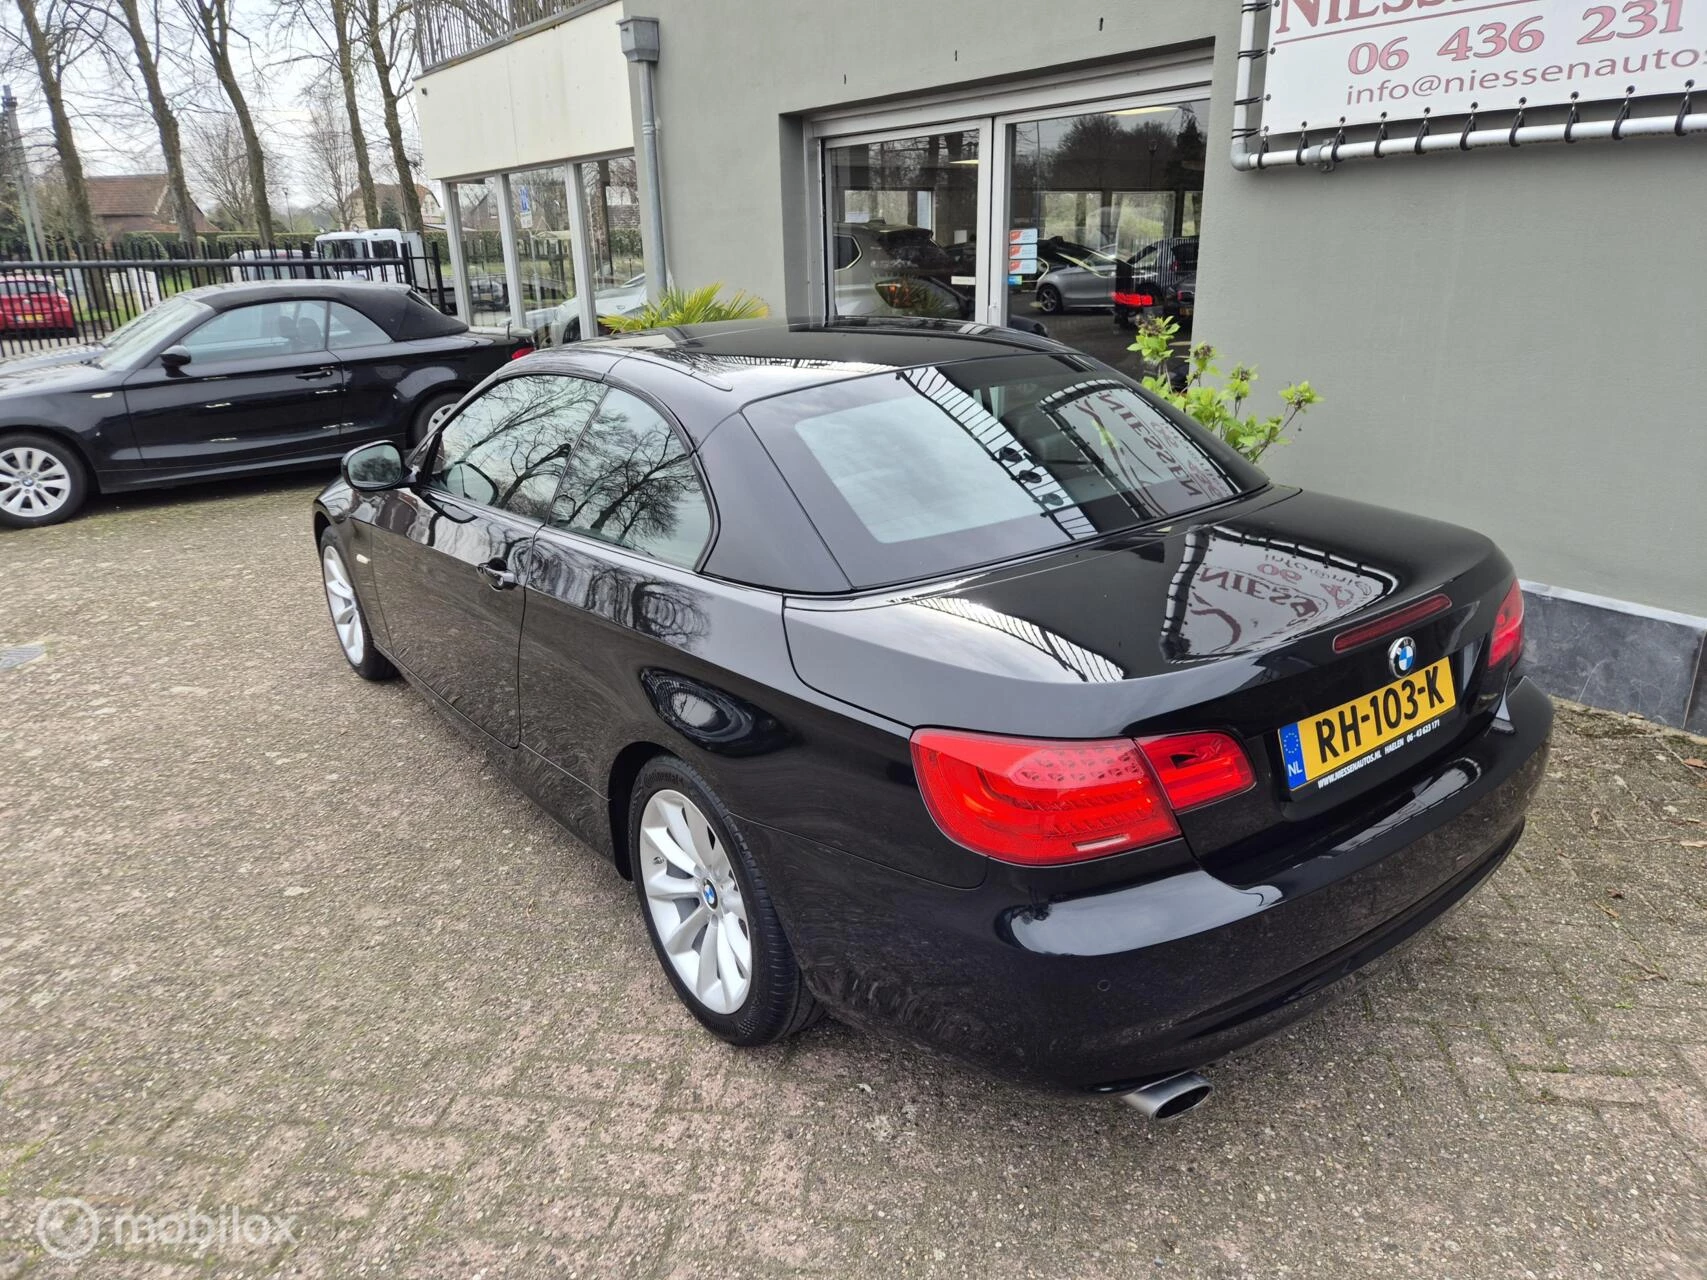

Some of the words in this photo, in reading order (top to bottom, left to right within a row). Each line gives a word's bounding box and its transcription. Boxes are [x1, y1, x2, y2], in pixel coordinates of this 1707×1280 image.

[1347, 36, 1410, 75] 06
[1436, 15, 1546, 62] 436
[1576, 0, 1684, 45] 231
[1314, 665, 1445, 765] RH-103-K
[1287, 760, 1303, 777] NL
